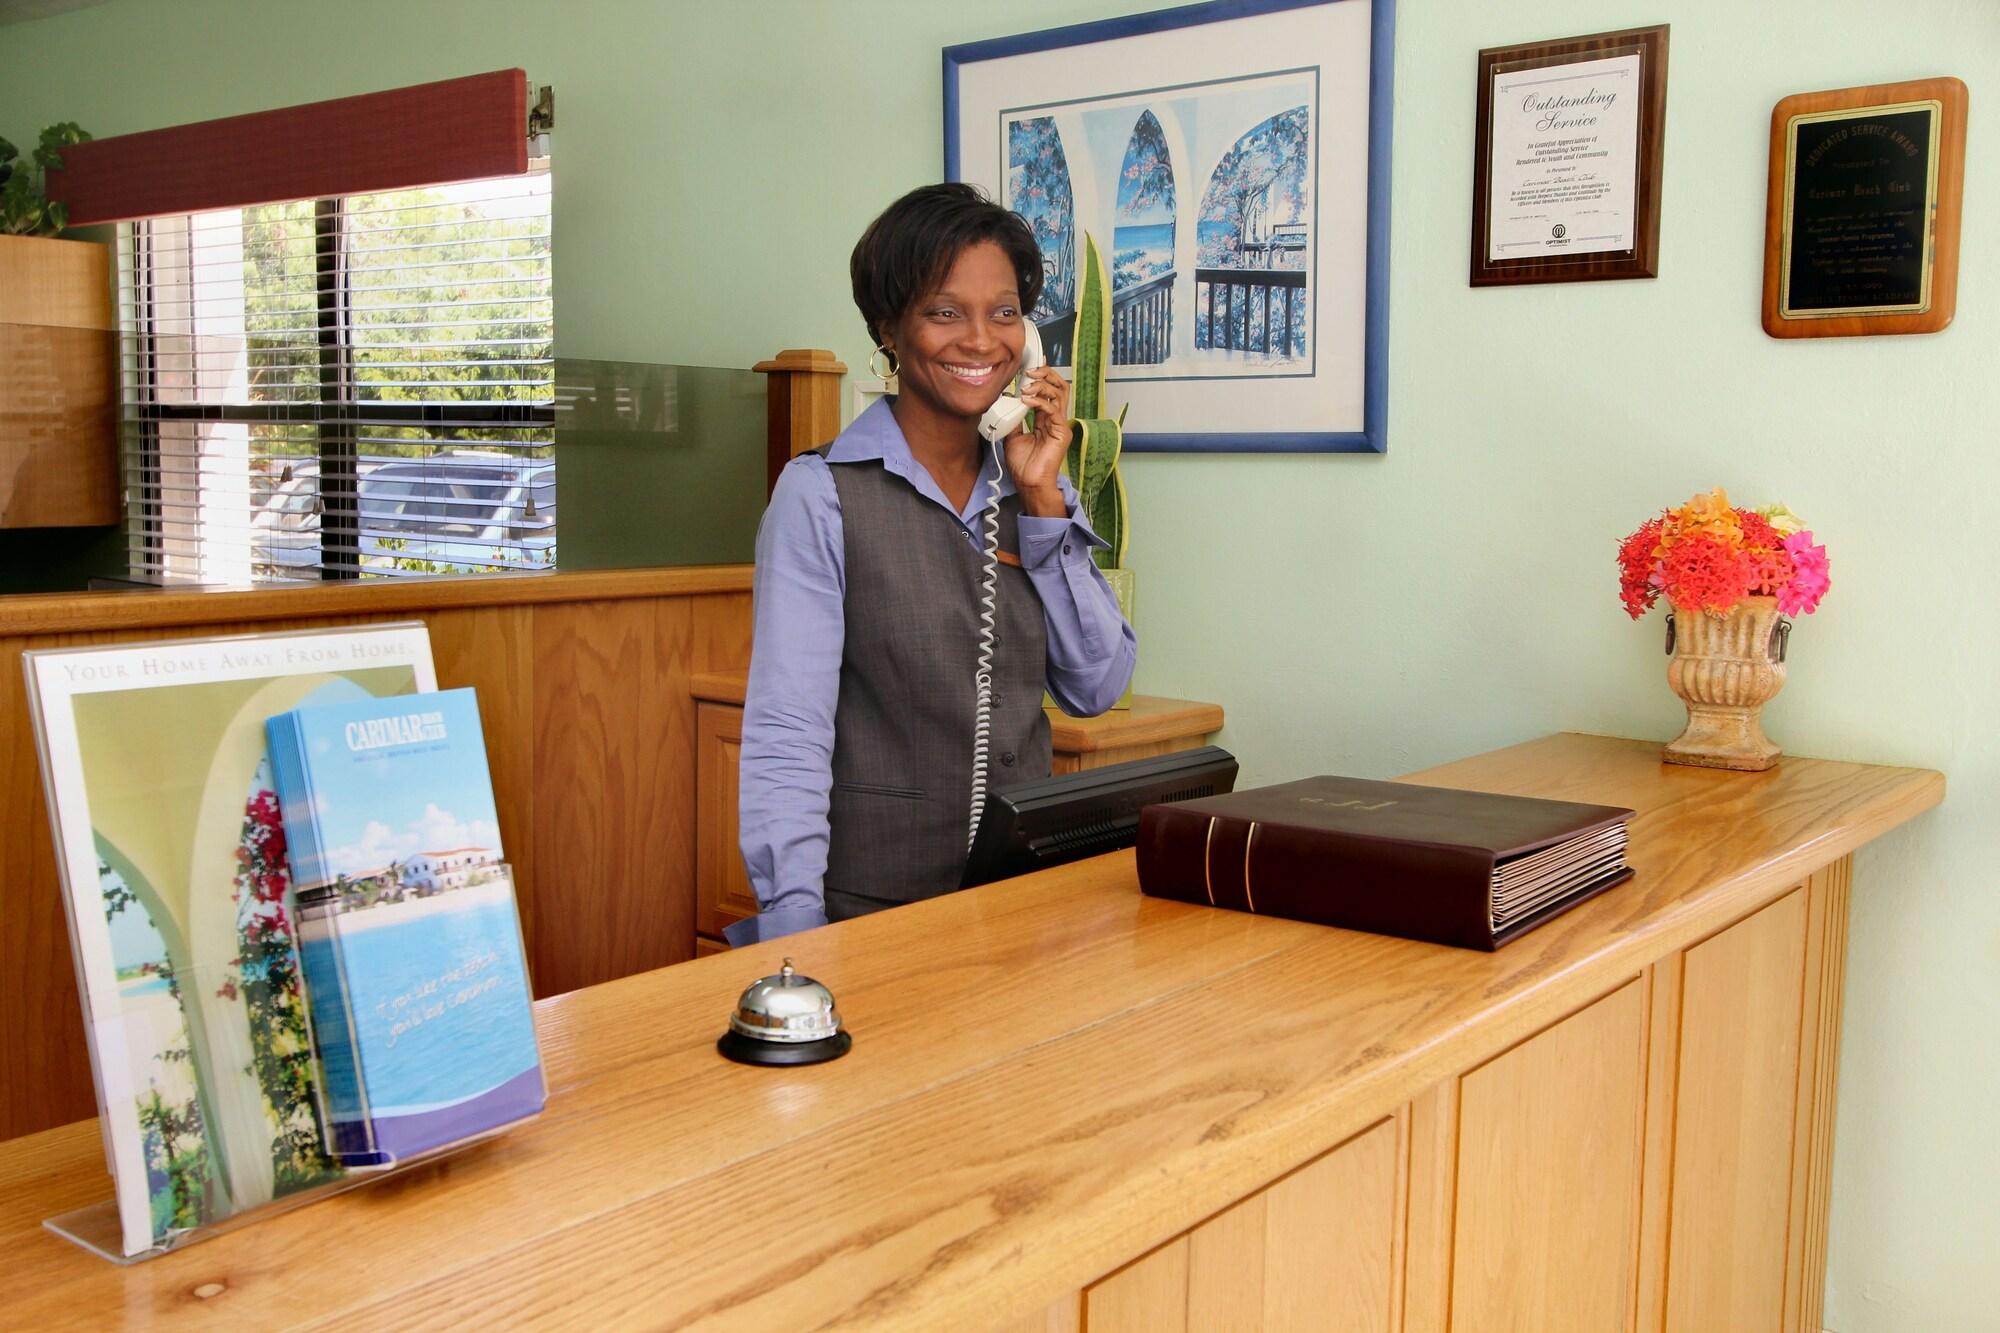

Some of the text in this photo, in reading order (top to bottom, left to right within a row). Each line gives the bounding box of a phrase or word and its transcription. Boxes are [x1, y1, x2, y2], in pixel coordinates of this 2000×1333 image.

[1522, 88, 1617, 113] Outstanding
[1536, 111, 1598, 131] Service
[1852, 125, 1889, 136] SERVICE
[64, 665, 129, 680] YOUR
[143, 658, 207, 675] HOME
[220, 653, 272, 669] AWAY
[286, 648, 339, 664] FROM
[346, 714, 424, 751] CARIMAR
